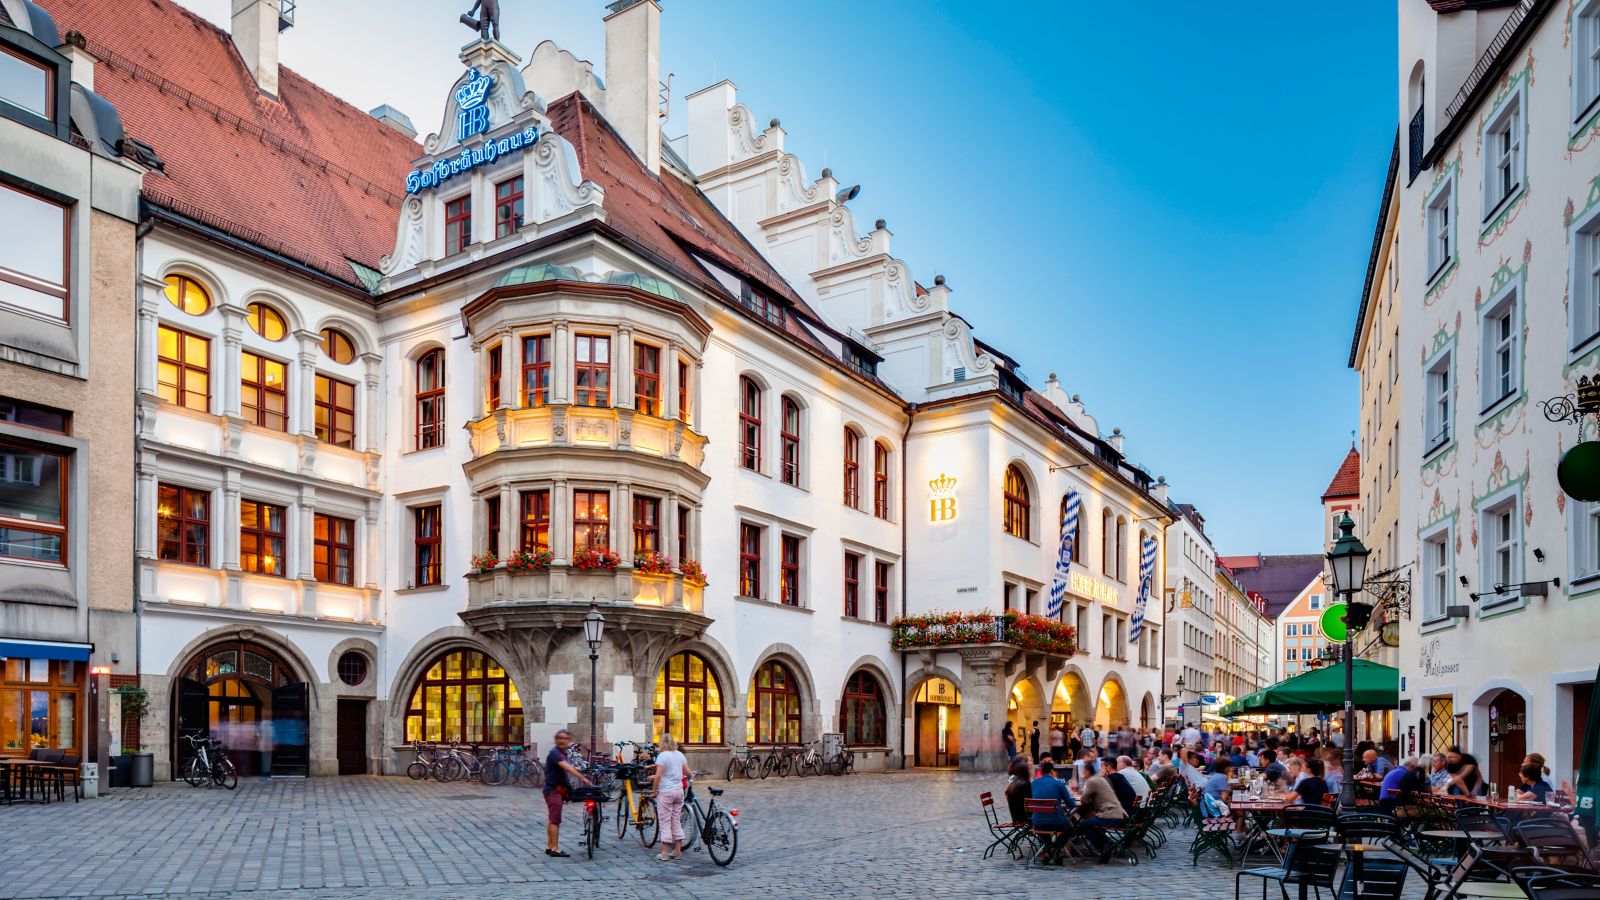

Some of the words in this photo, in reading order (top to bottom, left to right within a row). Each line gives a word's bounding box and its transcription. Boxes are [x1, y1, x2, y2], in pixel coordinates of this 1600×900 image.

[458, 105, 488, 142] HB
[406, 127, 537, 194] Hofbräuhaus
[930, 497, 957, 521] HB
